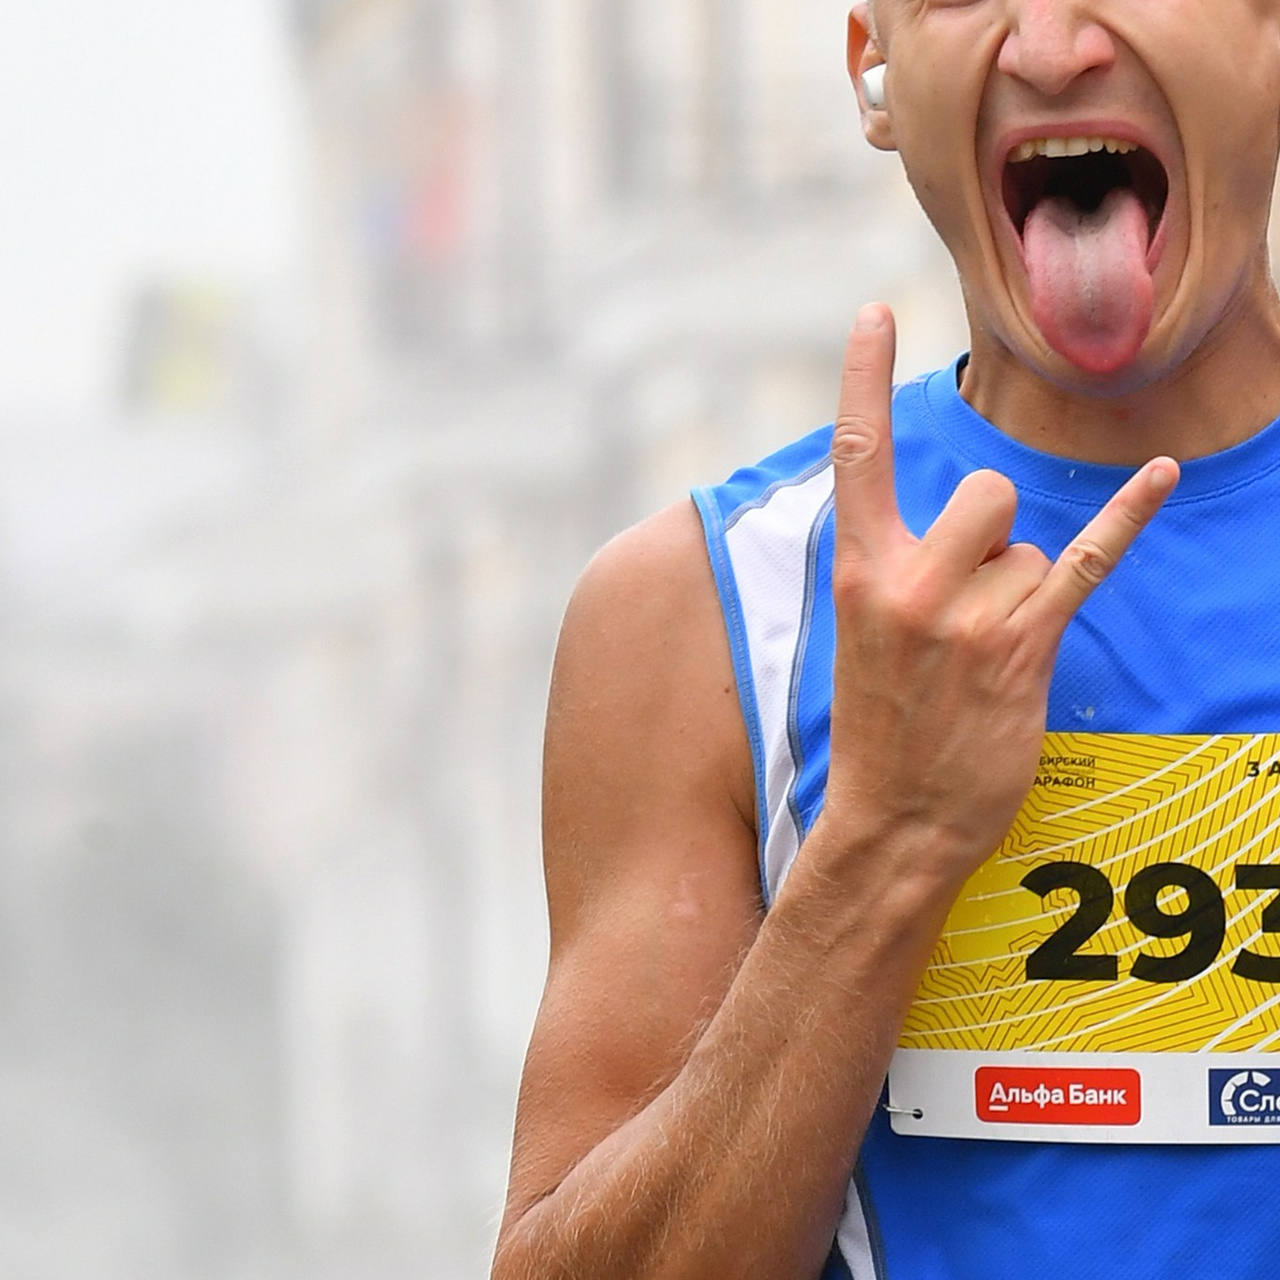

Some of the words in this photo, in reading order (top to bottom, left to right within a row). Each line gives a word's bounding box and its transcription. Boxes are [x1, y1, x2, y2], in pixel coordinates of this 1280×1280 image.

[1039, 756, 1096, 768] БИРСКИЙ
[1246, 761, 1260, 777] 3
[1033, 775, 1096, 788] АРАФОН
[989, 1082, 1065, 1110] Альфа
[1068, 1083, 1128, 1105] Банк
